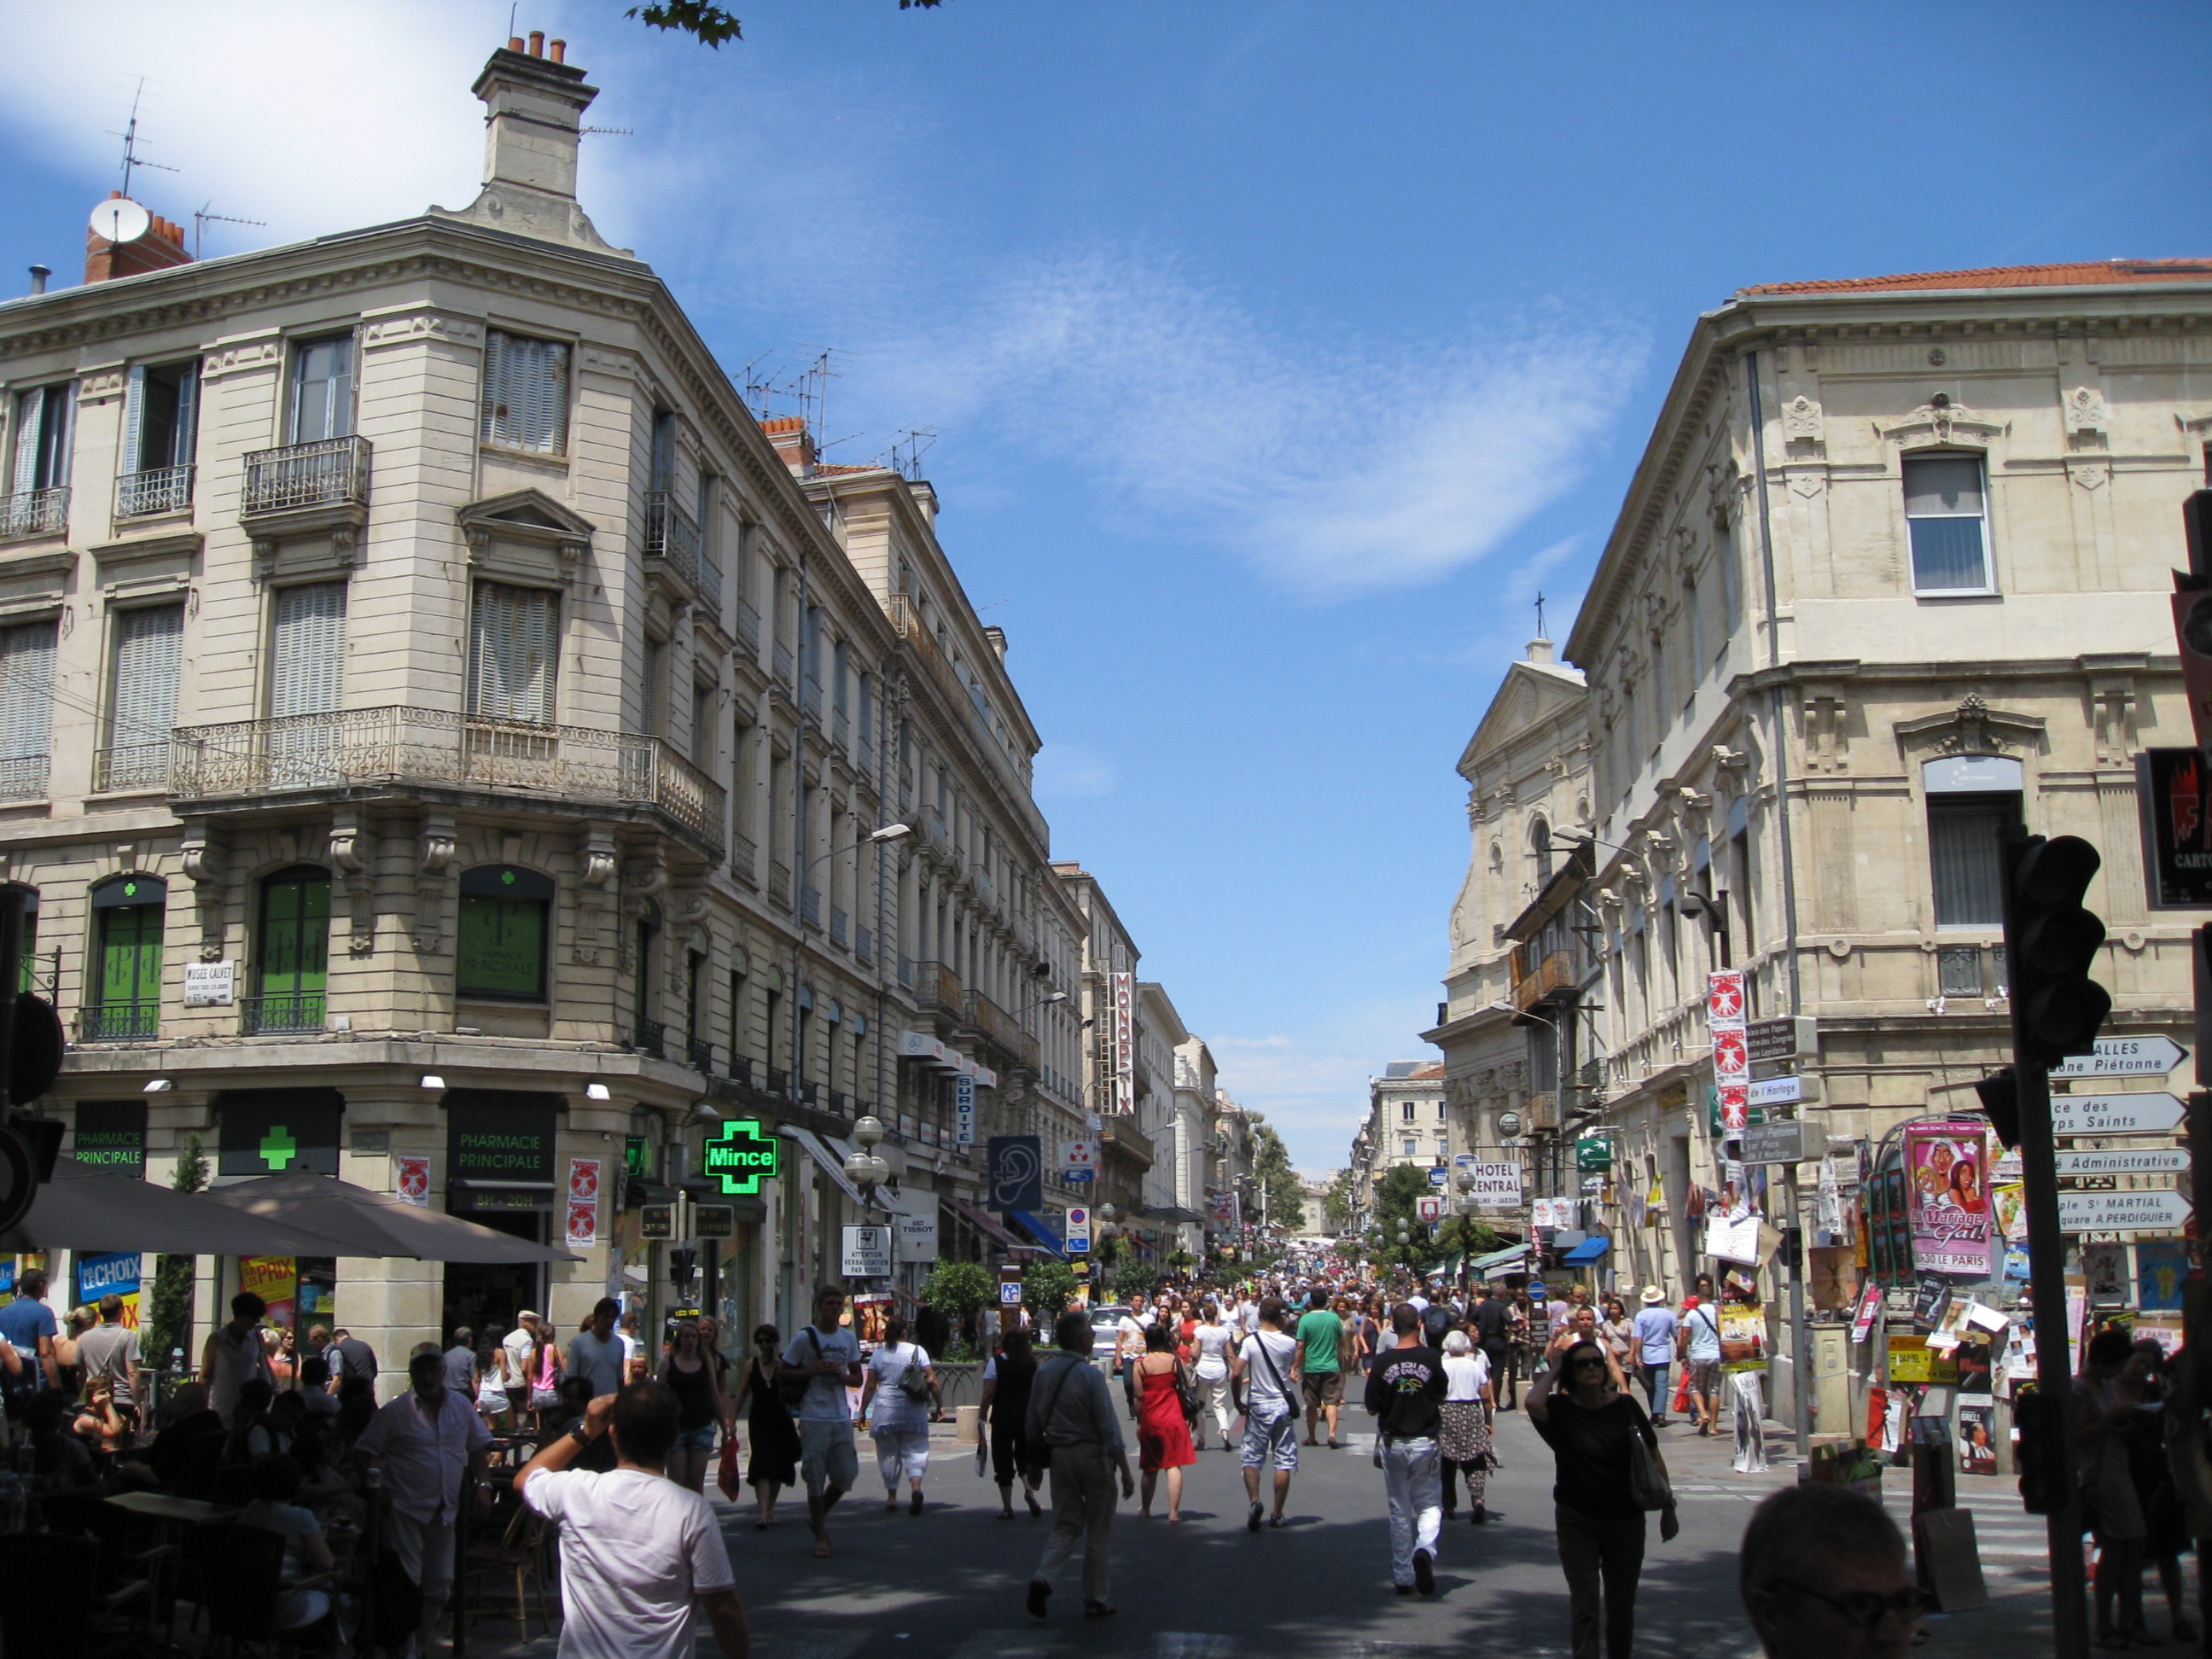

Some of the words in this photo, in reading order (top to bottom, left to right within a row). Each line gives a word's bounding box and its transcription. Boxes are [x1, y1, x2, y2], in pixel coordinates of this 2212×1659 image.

[2094, 1043, 2139, 1056] ALLES
[2094, 1058, 2162, 1071] Piétonne
[1750, 1089, 1759, 1097] de
[2083, 1102, 2108, 1112] des
[2087, 1116, 2135, 1127] Saints
[78, 1132, 141, 1145] PHARMACIE
[1747, 1130, 1765, 1139] Zone
[461, 1134, 540, 1150] PHARMACIE
[76, 1150, 141, 1164] PRINCIPALE
[459, 1154, 540, 1169] PRINCIPALE
[709, 1148, 772, 1166] Mince
[2071, 1155, 2179, 1169] Administrative
[1476, 1164, 1513, 1176] HOTEL
[476, 1194, 493, 1206] 8H
[507, 1195, 533, 1207] 20H
[2106, 1198, 2162, 1208] MARTIAL
[1926, 1209, 1983, 1228] Mariage
[2061, 1215, 2090, 1225] quare
[1938, 1255, 1947, 1265] LE
[1952, 1255, 1984, 1266] PARIS
[94, 1255, 141, 1288] CHOIX
[256, 1258, 294, 1284] PRIX
[2145, 1330, 2172, 1339] PARIS
